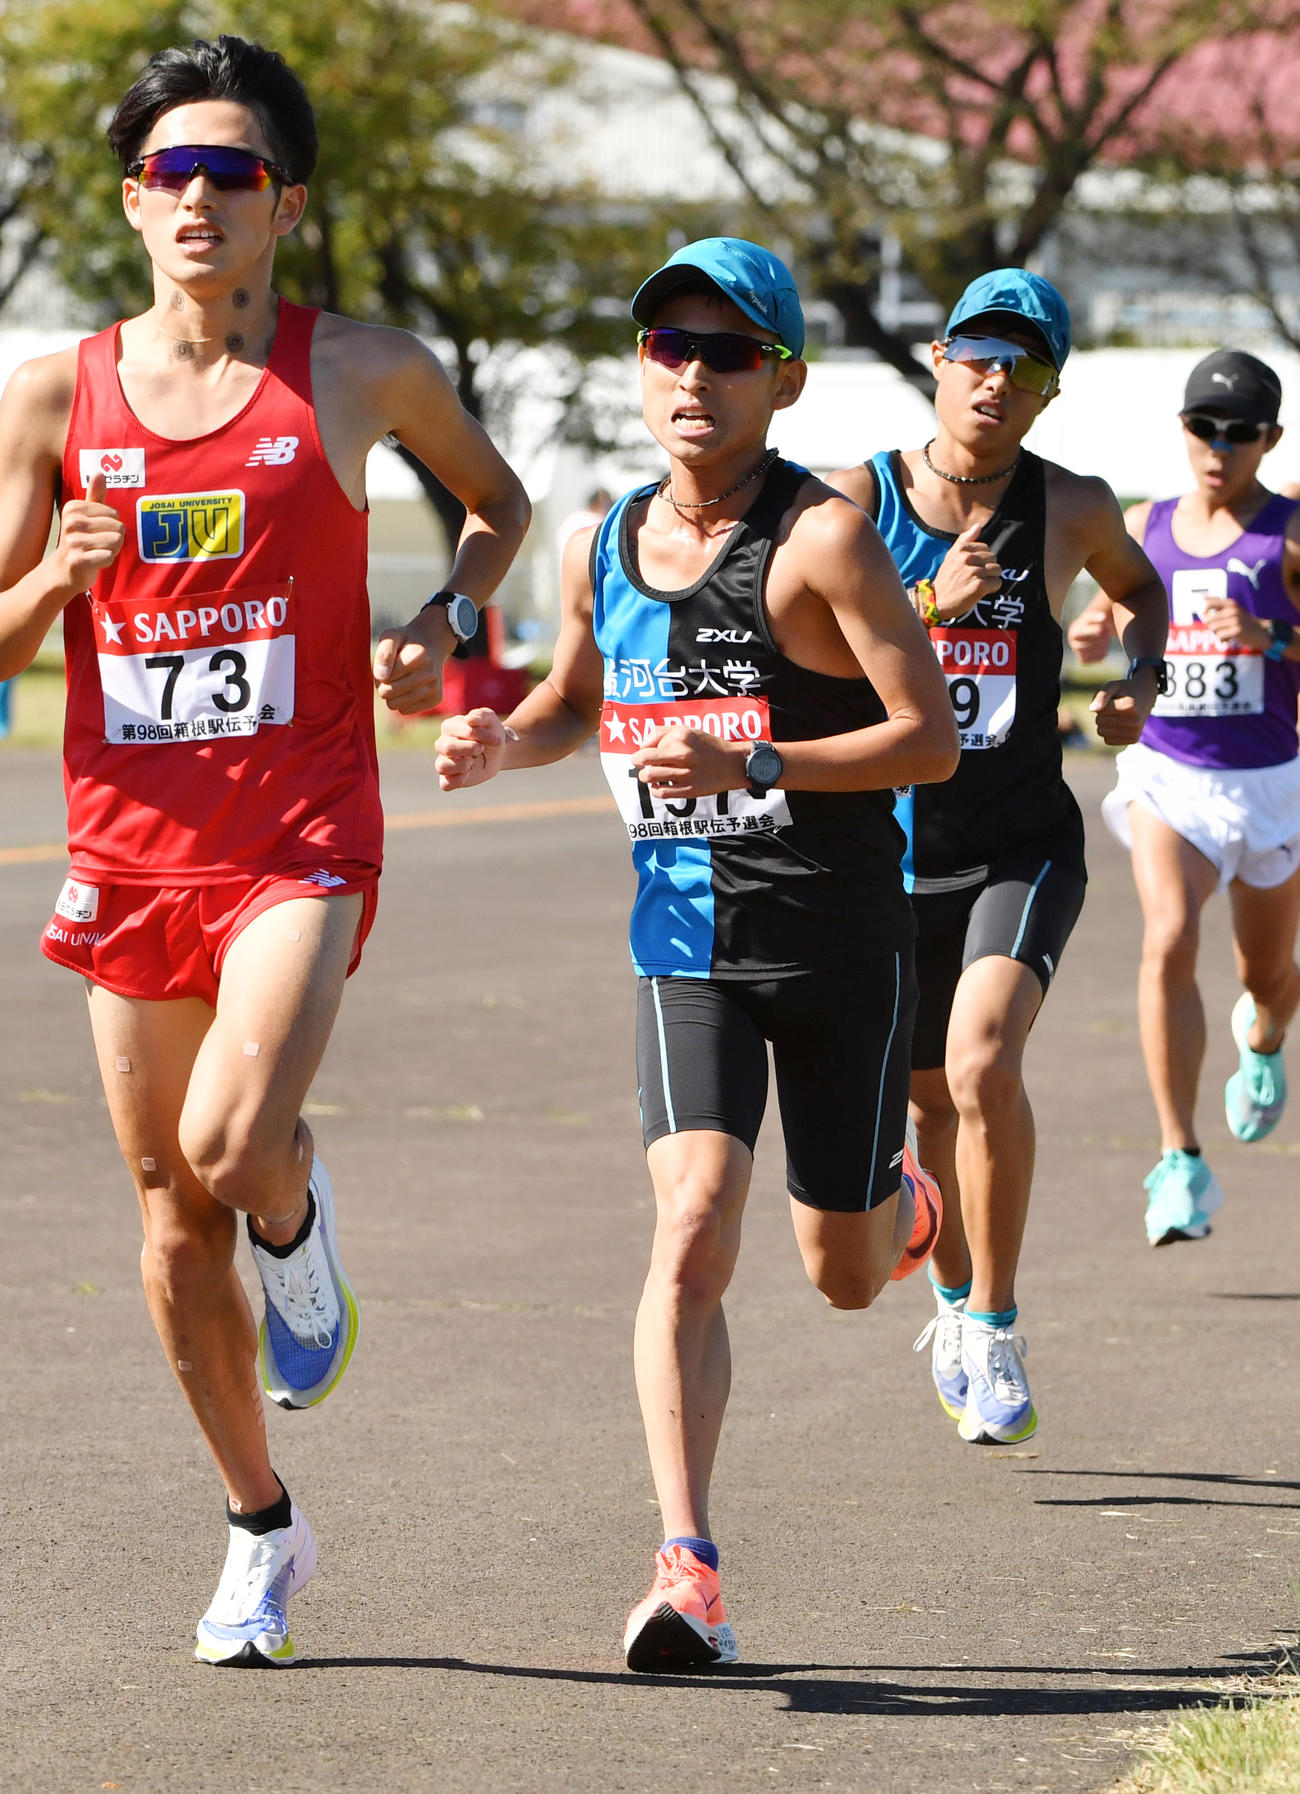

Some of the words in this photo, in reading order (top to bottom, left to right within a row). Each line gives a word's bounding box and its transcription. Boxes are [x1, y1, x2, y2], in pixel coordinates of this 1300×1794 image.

[149, 501, 175, 510] JOSAI
[179, 497, 233, 507] UNIVERSITY
[153, 507, 229, 556] JU
[135, 597, 288, 643] SAPPORO
[696, 628, 752, 643] 2XU
[931, 639, 1010, 667] PORO
[121, 703, 276, 741] 第98回箱根駅伝予会
